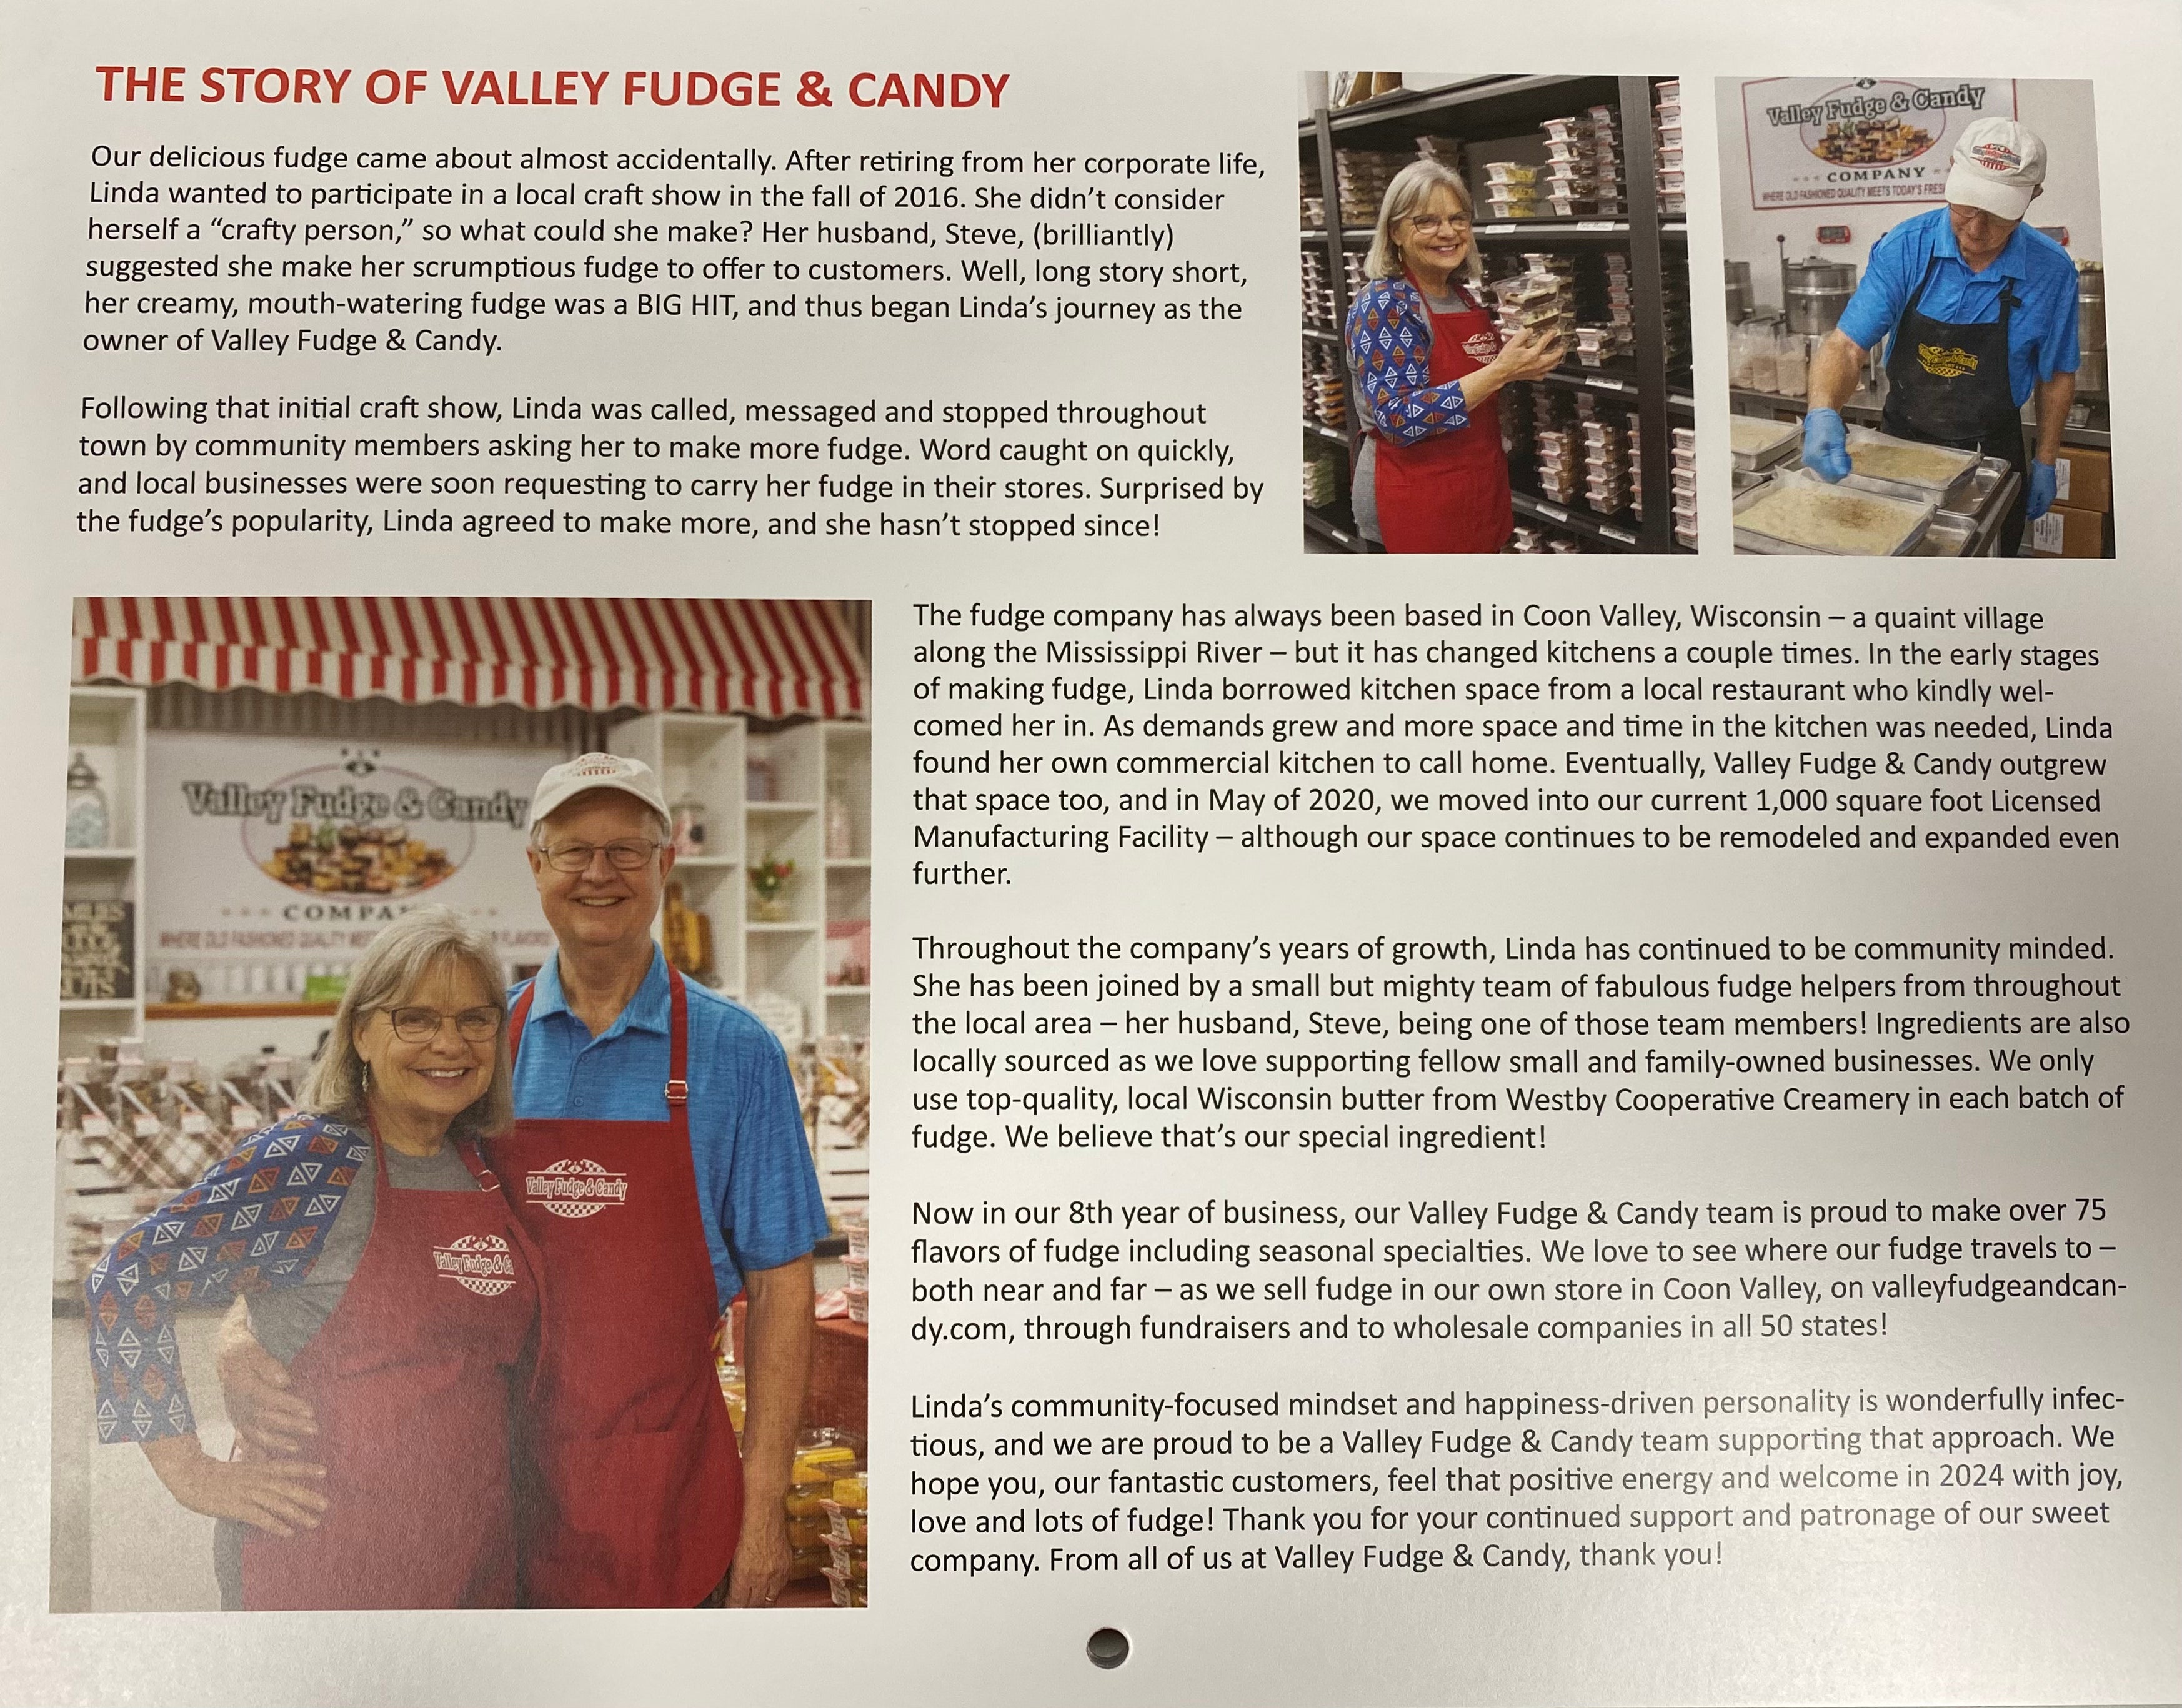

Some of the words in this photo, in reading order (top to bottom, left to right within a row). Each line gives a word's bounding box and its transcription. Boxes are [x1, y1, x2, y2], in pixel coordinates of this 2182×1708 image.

[95, 66, 186, 102] THE
[200, 67, 352, 104] STORY
[366, 69, 427, 105] OF
[442, 70, 610, 106] VALLEY
[624, 71, 781, 107] FUDGE
[796, 71, 833, 107] &
[849, 72, 1010, 109] CANDY
[1766, 104, 1823, 125] Valley
[1826, 96, 1887, 119] Fudge
[1891, 92, 1909, 111] &
[1912, 84, 1985, 110] Candy
[91, 145, 142, 167] Our
[149, 144, 265, 168] delicious
[273, 145, 348, 174] fudge
[356, 152, 427, 169] came
[435, 146, 512, 169] about
[520, 147, 609, 170] almost
[617, 147, 777, 176] accidentally.
[785, 148, 852, 171] After
[860, 150, 954, 177] retiring
[961, 149, 1024, 173] from
[1034, 151, 1077, 174] her
[1084, 154, 1210, 179] corporate
[1220, 152, 1265, 179] life,
[1827, 167, 1925, 182] COMPANY
[1837, 186, 1866, 199] QUALITY
[1867, 186, 1890, 197] MEETS
[83, 334, 169, 351] owner
[176, 327, 205, 351] of
[211, 327, 290, 357] Valley
[298, 327, 377, 357] Fudge
[386, 328, 407, 351] &
[415, 327, 502, 357] Candy.
[76, 508, 120, 532] the
[128, 508, 223, 537] fudge’s
[232, 508, 373, 537] popularity,
[384, 508, 453, 532] Linda
[462, 509, 554, 538] agreed
[562, 512, 591, 533] to
[600, 509, 672, 534] make
[681, 517, 759, 539] more,
[768, 511, 816, 535] and
[825, 511, 871, 535] she
[880, 512, 960, 536] hasn’t
[969, 512, 1075, 542] stopped
[1084, 513, 1159, 537] since!
[914, 675, 942, 700] of
[949, 676, 1044, 705] making
[1051, 676, 1134, 706] fudge,
[1144, 676, 1212, 700] Linda
[1222, 676, 1350, 700] borrowed
[1360, 676, 1456, 700] kitchen
[1465, 683, 1540, 706] space
[1548, 676, 1611, 700] from
[1620, 683, 1634, 700] a
[1644, 676, 1703, 700] local
[1712, 680, 1846, 701] restaurant
[1853, 677, 1908, 702] who
[1917, 678, 1992, 708] kindly
[1999, 678, 2054, 702] wel-
[182, 780, 287, 824] Valley
[289, 785, 390, 825] Fudge
[393, 787, 424, 821] &
[427, 786, 531, 830] Candy
[912, 860, 1011, 885] further.
[913, 1048, 997, 1078] locally
[1005, 1048, 1109, 1072] sourced
[1118, 1054, 1147, 1072] as
[1154, 1054, 1193, 1072] we
[1203, 1048, 1257, 1072] love
[1265, 1049, 1411, 1078] supporting
[1418, 1048, 1501, 1073] fellow
[1509, 1048, 1578, 1073] small
[1588, 1049, 1636, 1073] and
[1645, 1048, 1825, 1079] family-owned
[1835, 1048, 1980, 1073] businesses.
[1988, 1048, 2031, 1071] We
[2040, 1047, 2095, 1077] only
[526, 1176, 555, 1199] Valley
[555, 1176, 584, 1199] Fudge
[585, 1178, 595, 1196] &
[595, 1178, 628, 1201] Candy
[913, 1201, 974, 1225] Now
[983, 1200, 1005, 1224] in
[1015, 1206, 1061, 1224] our
[1069, 1199, 1112, 1224] 8th
[1121, 1206, 1180, 1229] year
[1188, 1199, 1217, 1224] of
[1224, 1199, 1345, 1229] business,
[1355, 1206, 1401, 1224] our
[1408, 1199, 1488, 1230] Valley
[1498, 1200, 1578, 1231] Fudge
[1587, 1201, 1608, 1225] &
[1617, 1199, 1699, 1230] Candy
[1706, 1203, 1773, 1224] team
[1783, 1199, 1802, 1223] is
[1811, 1198, 1887, 1229] proud
[1895, 1201, 1923, 1223] to
[1931, 1198, 2001, 1222] make
[2009, 1203, 2067, 1221] over
[2075, 1198, 2106, 1221] 75
[433, 1251, 463, 1274] Valley
[462, 1254, 492, 1277] Fudge
[492, 1254, 503, 1274] &
[911, 1316, 1015, 1346] dy.com,
[1024, 1314, 1131, 1346] through
[1139, 1314, 1290, 1339] fundraisers
[1299, 1314, 1348, 1339] and
[1357, 1317, 1385, 1339] to
[1393, 1314, 1529, 1339] wholesale
[1538, 1314, 1682, 1344] companies
[1691, 1314, 1713, 1338] in
[1723, 1313, 1751, 1338] all
[1761, 1314, 1793, 1338] 50
[1801, 1311, 1886, 1337] states!
[912, 1470, 979, 1501] hope
[987, 1476, 1045, 1501] you,
[1054, 1476, 1101, 1494] our
[1108, 1469, 1224, 1494] fantastic
[1232, 1471, 1378, 1496] customers,
[1387, 1467, 1436, 1492] feel
[1445, 1466, 1500, 1491] that
[1510, 1467, 1613, 1497] positive
[1622, 1472, 1713, 1495] energy
[1721, 1464, 1770, 1489] and
[1778, 1464, 1898, 1488] welcome
[1908, 1464, 1930, 1487] in
[1940, 1463, 2005, 1487] 2024
[2012, 1461, 2070, 1486] with
[2077, 1462, 2122, 1491] joy,
[910, 1553, 1040, 1577] company.
[1050, 1547, 1118, 1571] From
[1128, 1545, 1157, 1571] all
[1167, 1545, 1195, 1570] of
[1203, 1551, 1232, 1570] us
[1241, 1547, 1267, 1569] at
[1274, 1544, 1355, 1574] Valley
[1364, 1543, 1444, 1573] Fudge
[1453, 1543, 1474, 1567] &
[1483, 1542, 1570, 1572] Candy,
[1579, 1541, 1656, 1566] thank
[1663, 1541, 1721, 1571] you!
